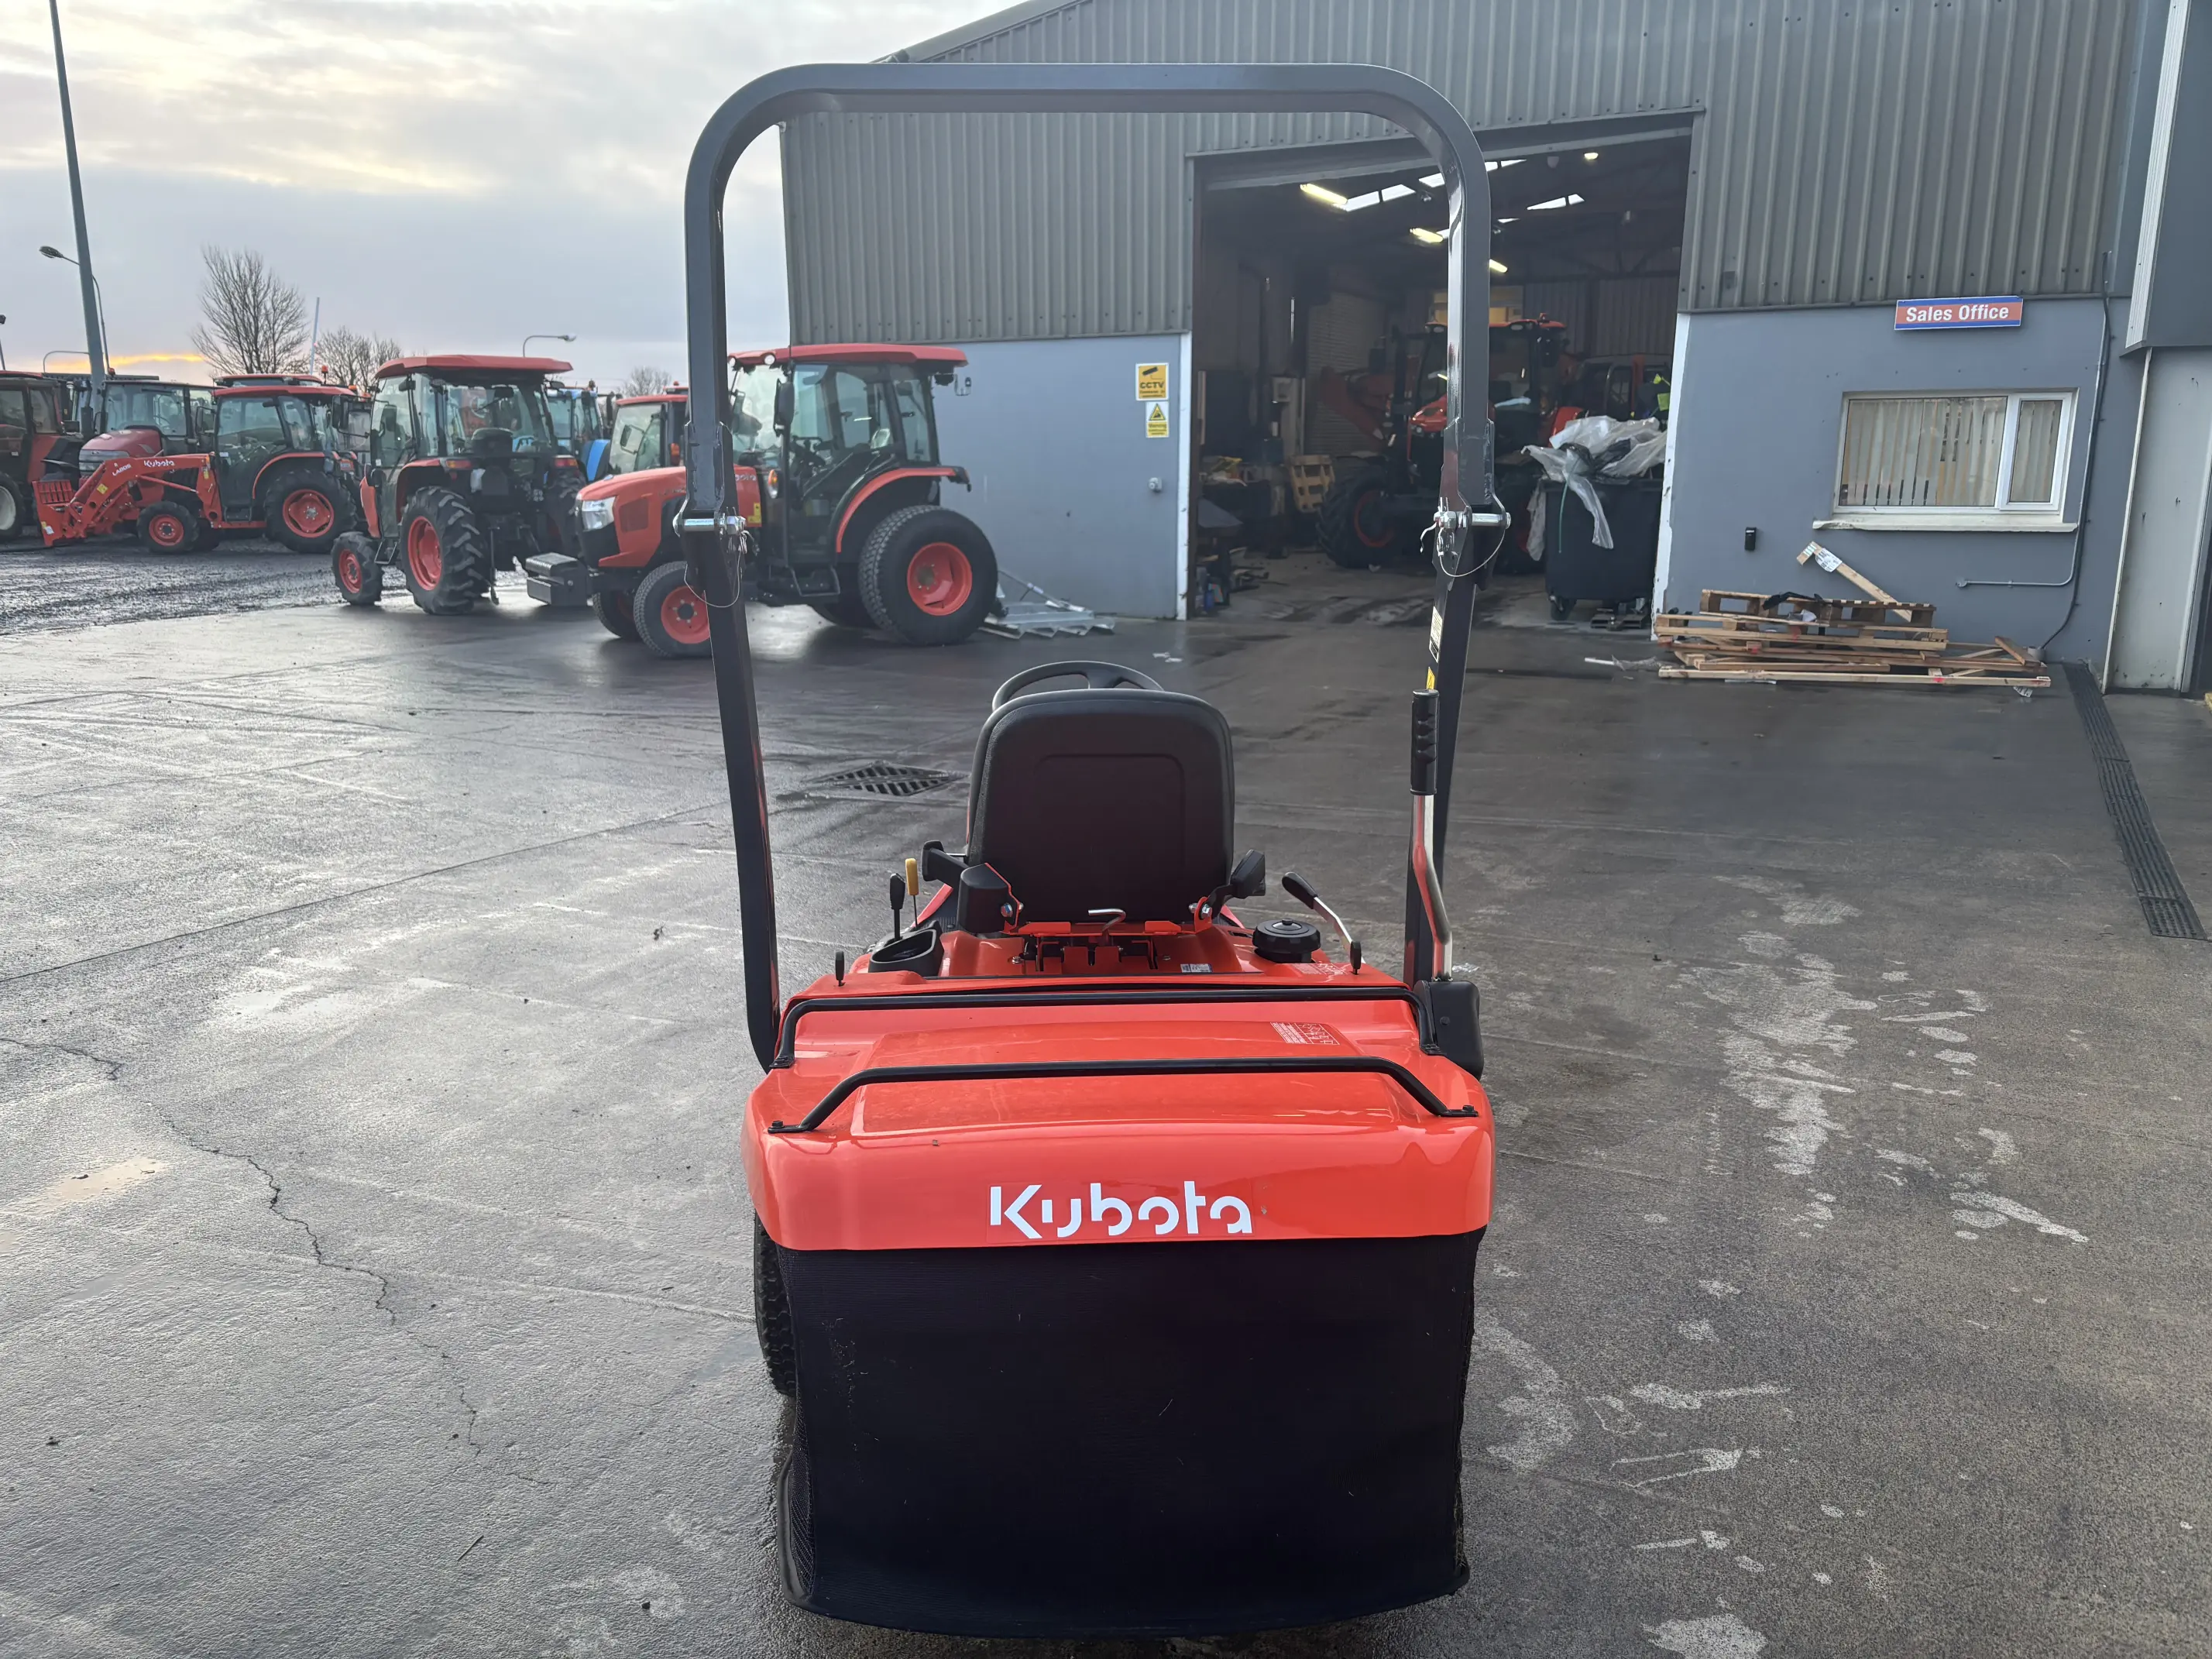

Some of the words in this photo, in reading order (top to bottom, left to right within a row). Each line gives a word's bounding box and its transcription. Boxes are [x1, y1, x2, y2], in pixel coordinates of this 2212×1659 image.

[1906, 306, 1953, 322] Sales
[1958, 304, 2009, 320] Office
[143, 459, 175, 468] Kubota
[990, 1180, 1252, 1239] Kubota
